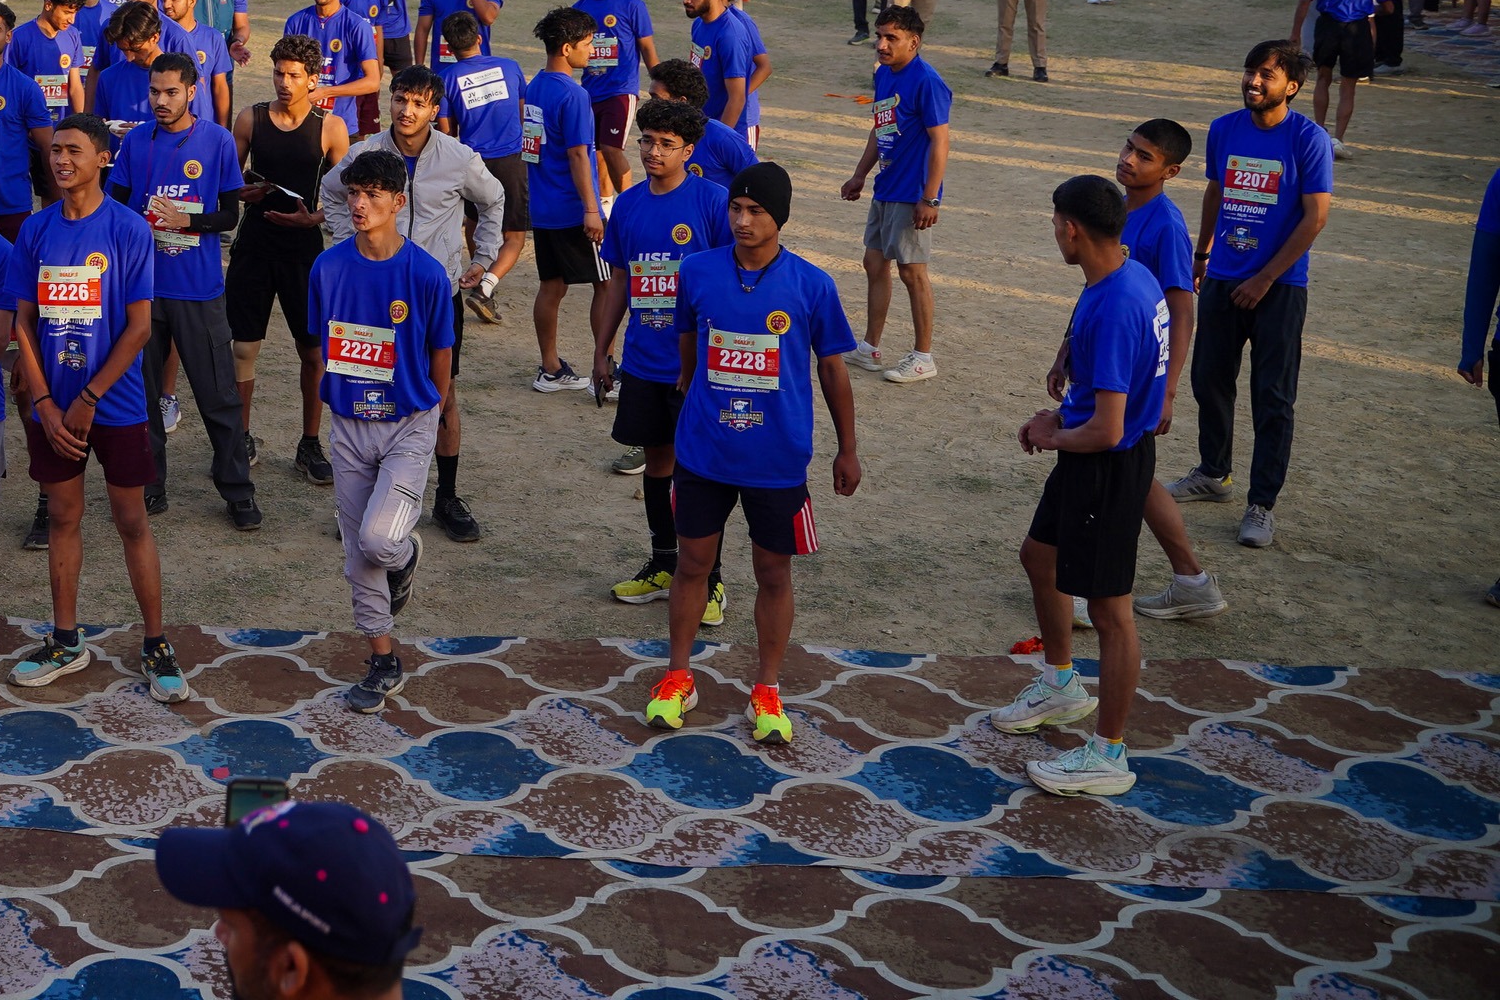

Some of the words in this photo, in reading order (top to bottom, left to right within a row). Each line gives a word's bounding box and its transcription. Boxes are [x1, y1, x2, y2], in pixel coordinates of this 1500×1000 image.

[467, 90, 505, 105] micronics
[468, 91, 477, 99] JV
[877, 110, 893, 125] 2152
[1233, 170, 1270, 189] 2207
[156, 184, 190, 198] USF
[48, 283, 90, 301] 2226
[640, 276, 677, 293] 2164
[340, 339, 383, 362] 2227
[720, 349, 766, 371] 2228
